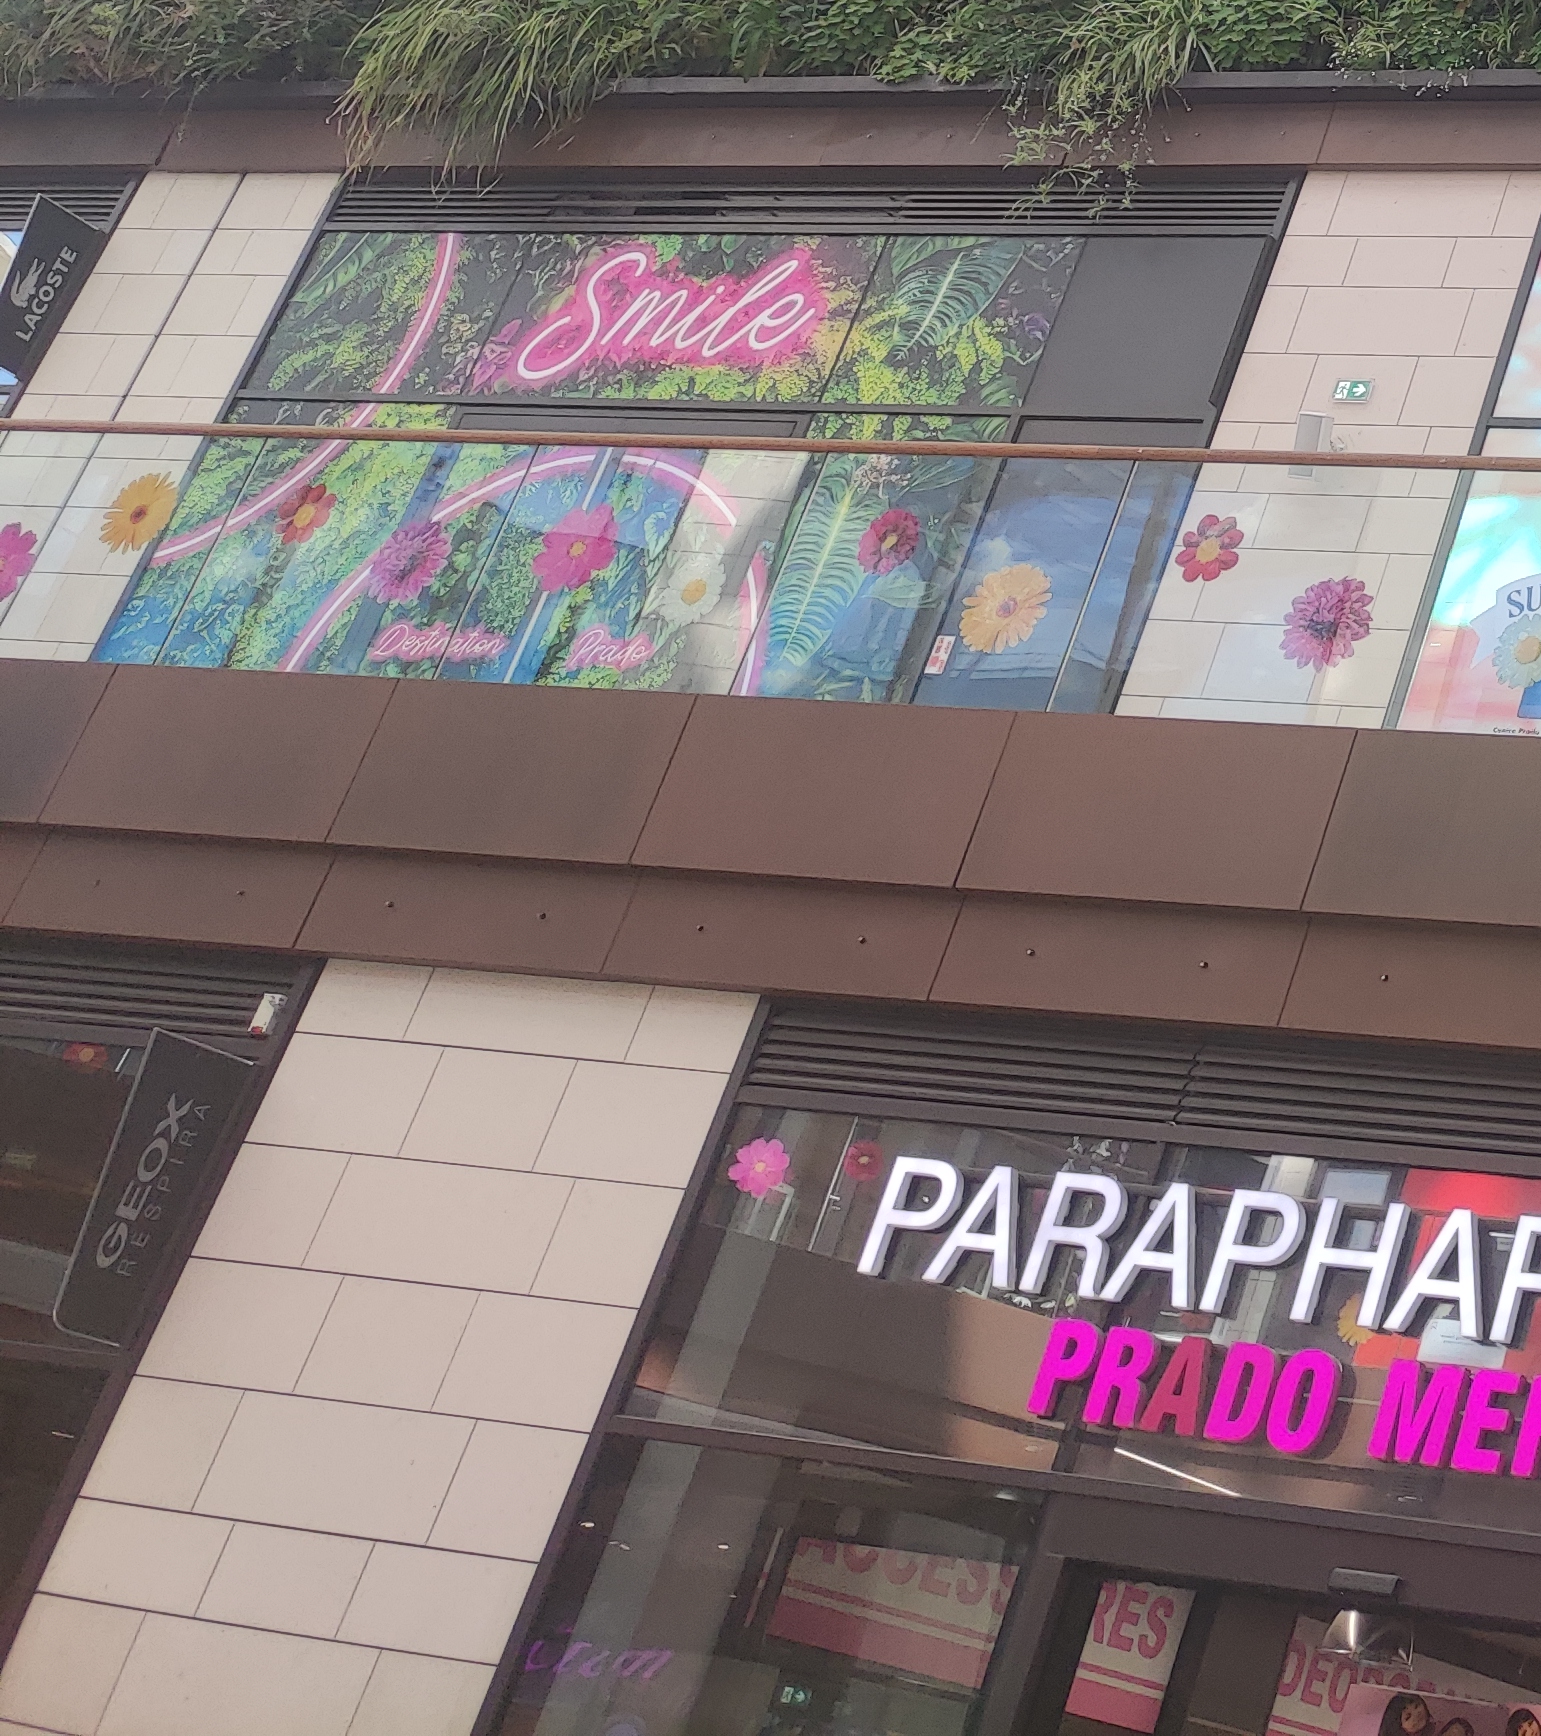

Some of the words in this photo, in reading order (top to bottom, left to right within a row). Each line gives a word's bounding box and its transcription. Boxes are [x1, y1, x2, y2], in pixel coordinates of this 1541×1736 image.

[15, 246, 78, 342] LACOSTE
[517, 251, 816, 380] Smile
[375, 624, 506, 657] Destination
[571, 629, 650, 666] Prado
[96, 1093, 194, 1269] GEOX
[117, 1105, 212, 1277] RESPIRA
[1027, 1318, 1343, 1454] PRADO
